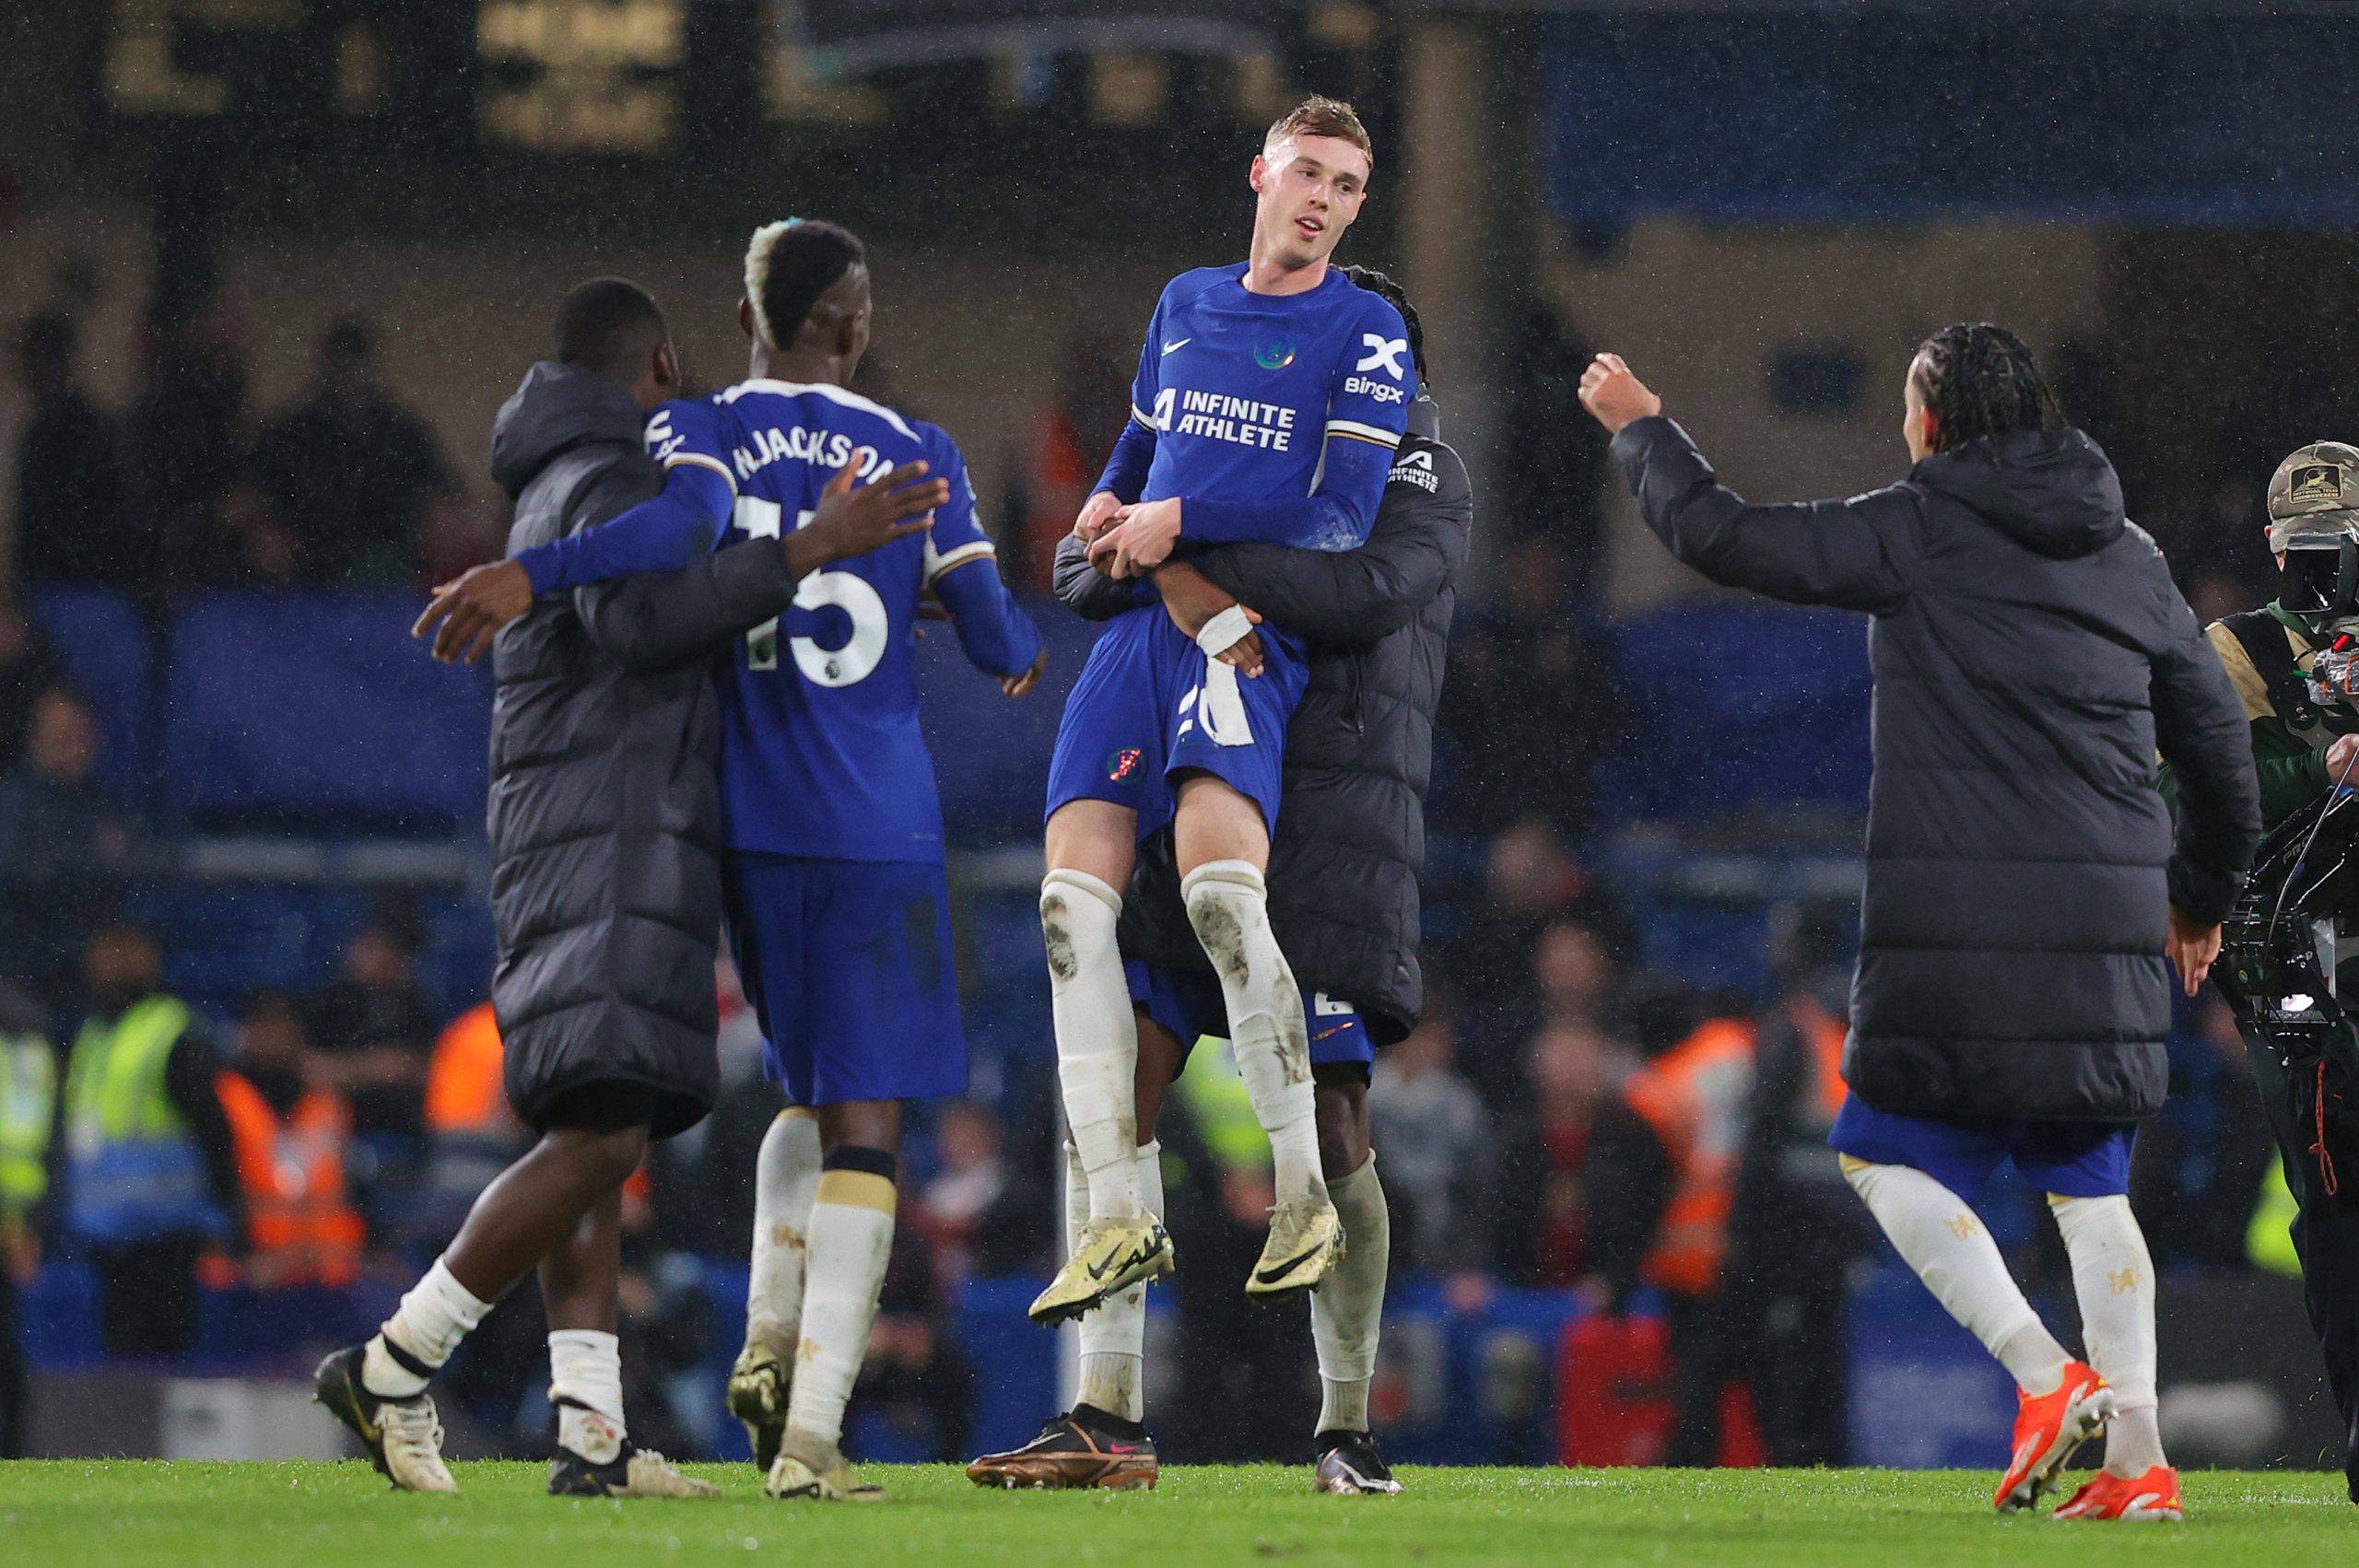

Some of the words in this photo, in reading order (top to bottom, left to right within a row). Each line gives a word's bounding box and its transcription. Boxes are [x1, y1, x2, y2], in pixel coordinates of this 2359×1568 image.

[1182, 390, 1297, 429] INFINITE
[1176, 414, 1292, 452] ATHLETE
[1387, 474, 1438, 494] ATHLETE
[1388, 467, 1438, 485] INFINITE
[734, 495, 888, 688] 15
